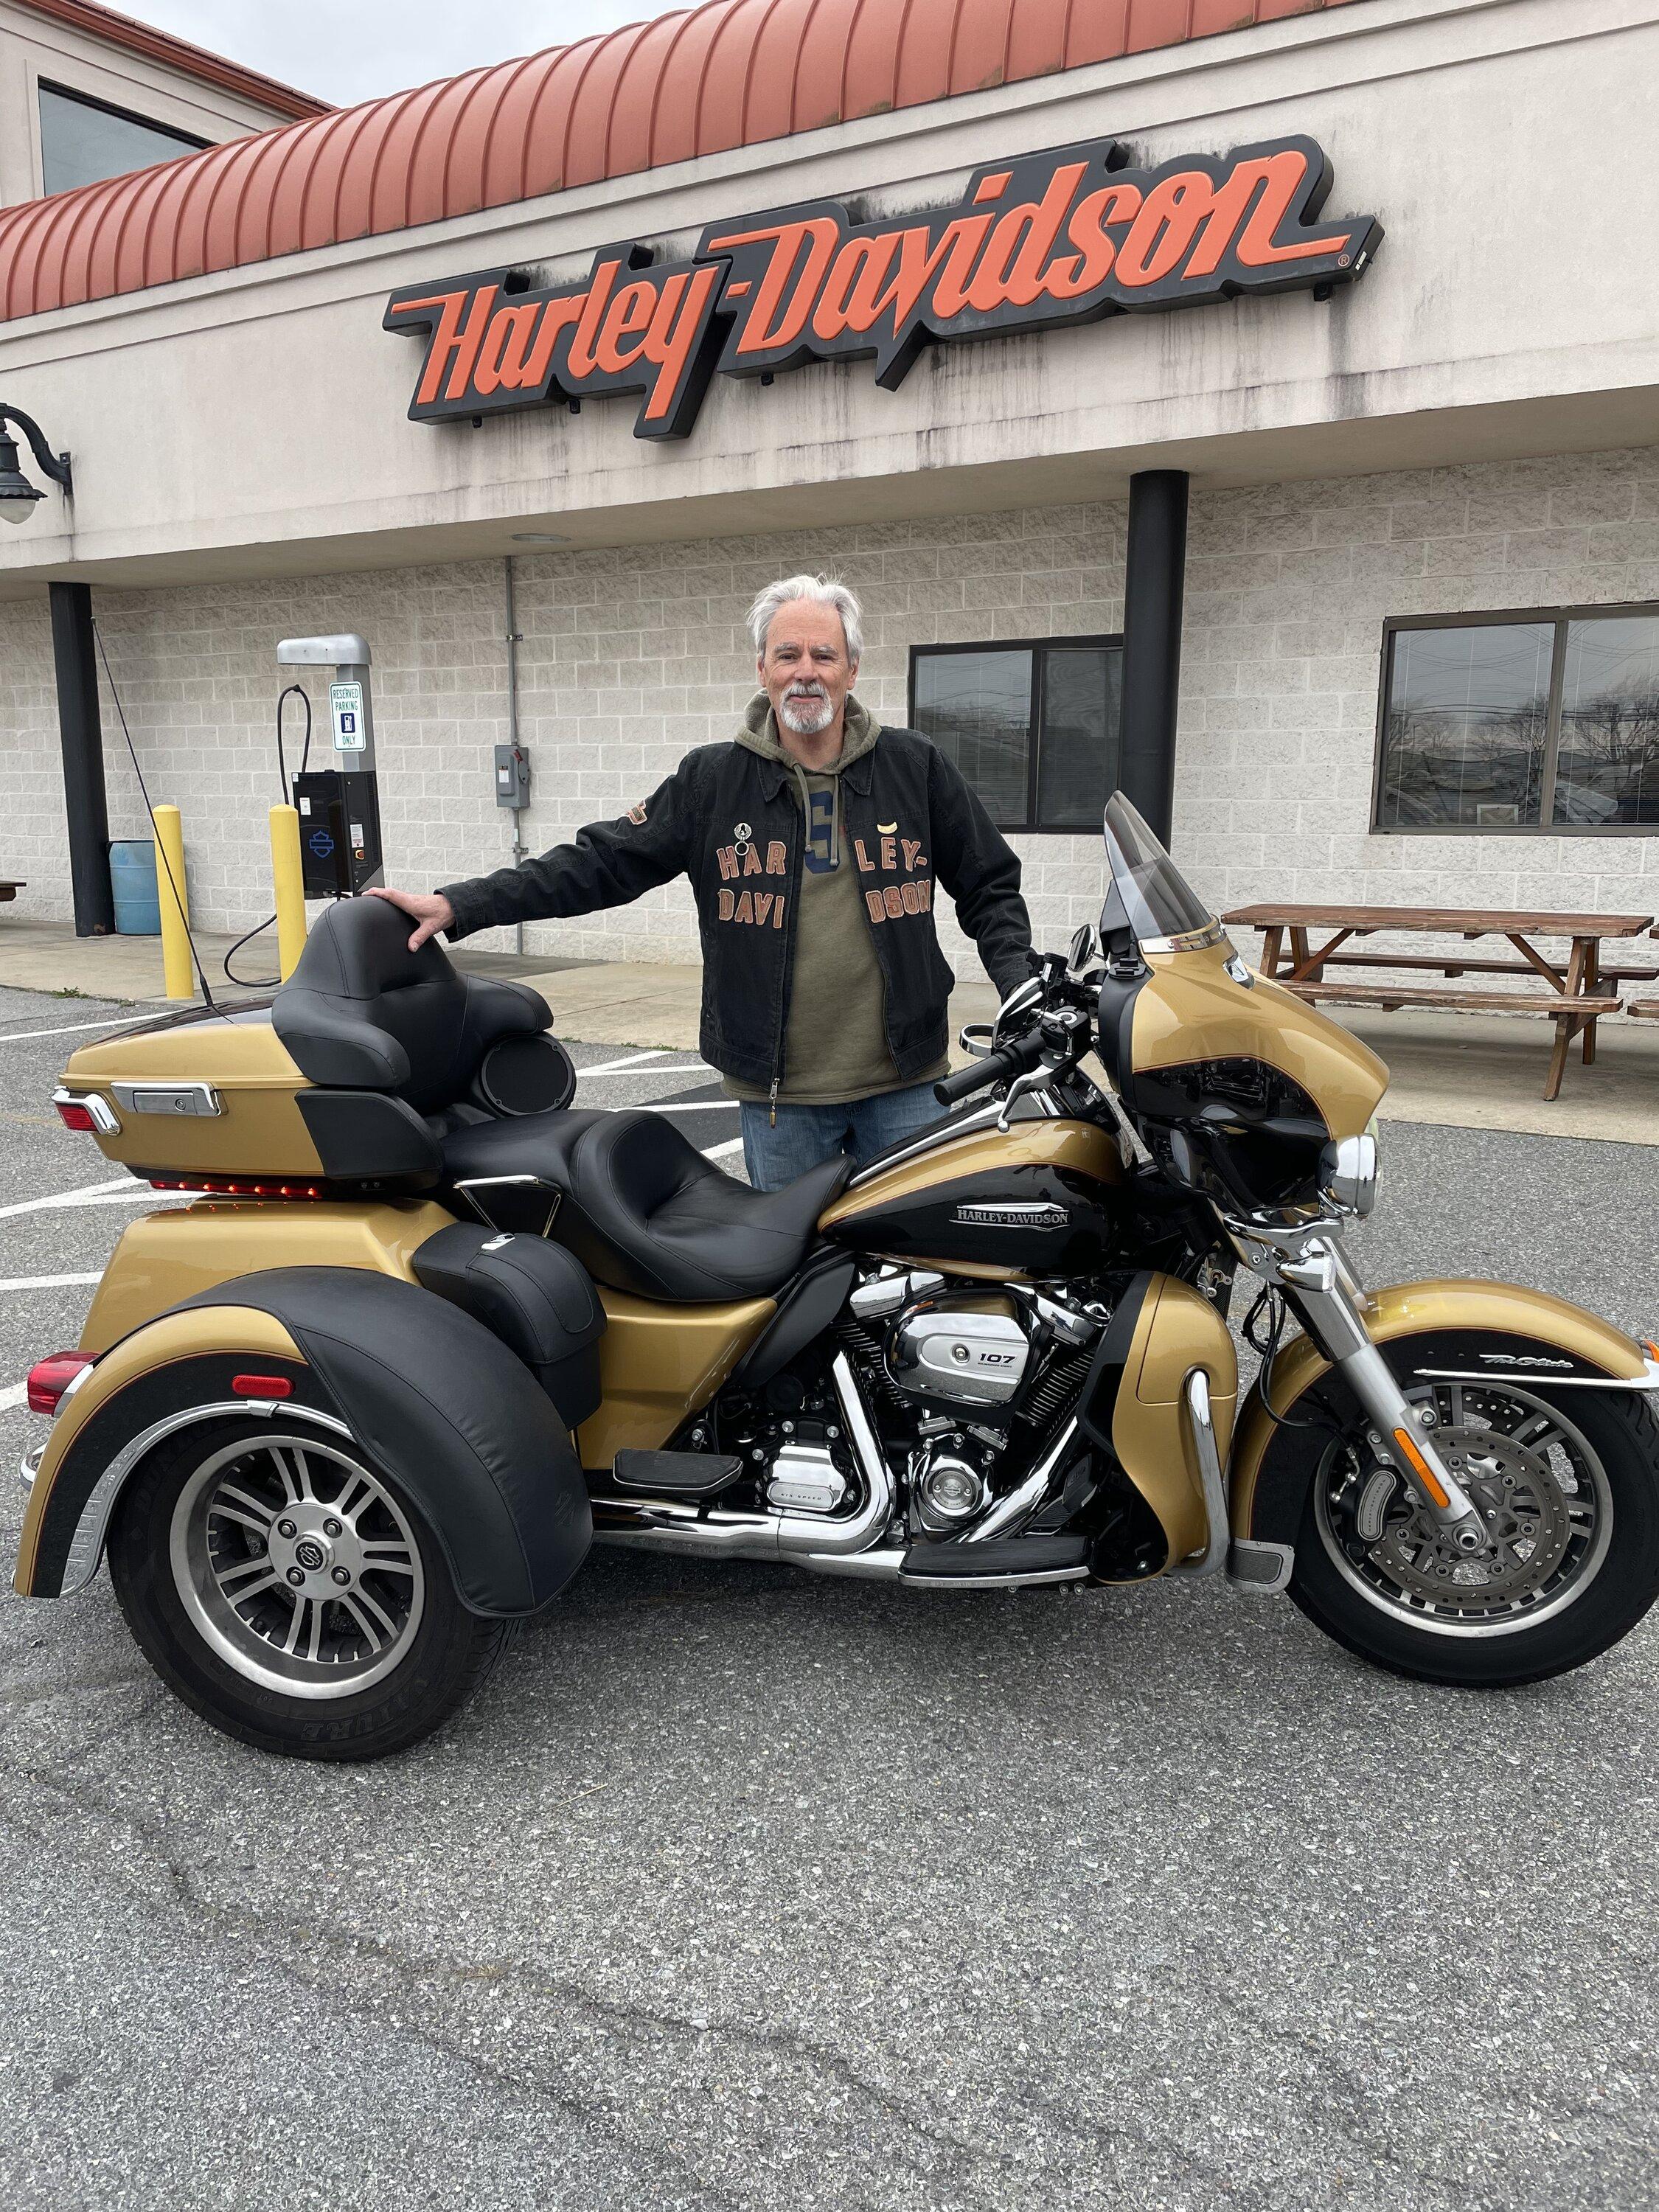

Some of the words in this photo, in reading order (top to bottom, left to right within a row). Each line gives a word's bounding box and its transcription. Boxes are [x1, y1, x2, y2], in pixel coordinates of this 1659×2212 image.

[333, 687, 358, 700] RESERVED
[335, 700, 358, 712] PARKING
[342, 735, 355, 745] ONLY
[717, 888, 785, 929] DAVI
[865, 879, 931, 924] DSON
[957, 1209, 1068, 1224] HARLEY-DAVIDSON
[979, 1353, 1016, 1364] 107
